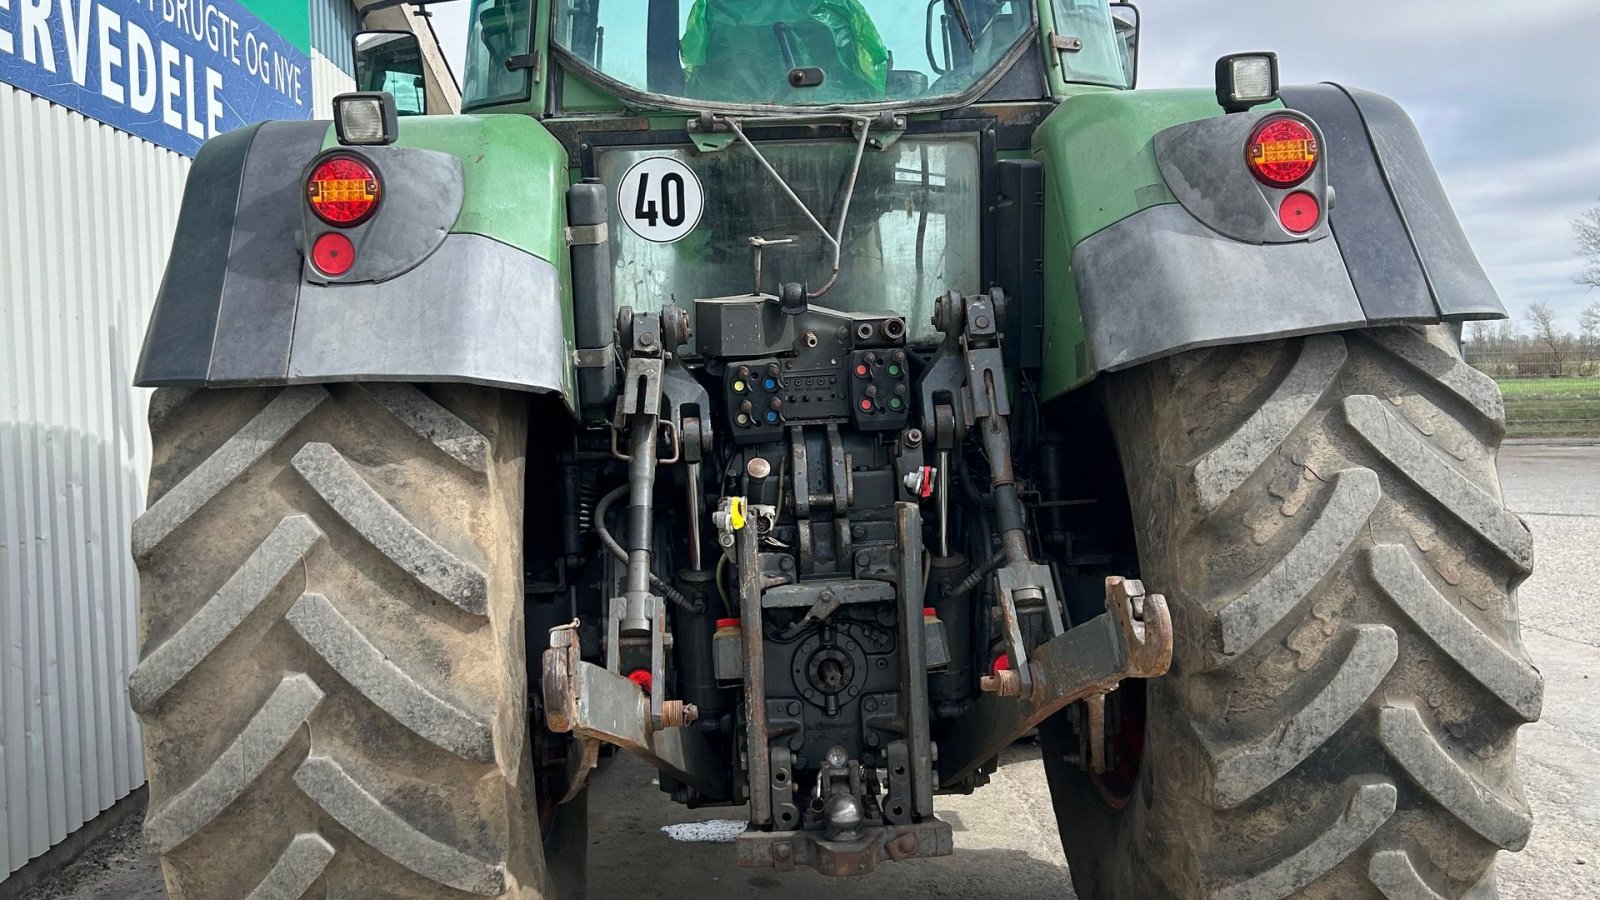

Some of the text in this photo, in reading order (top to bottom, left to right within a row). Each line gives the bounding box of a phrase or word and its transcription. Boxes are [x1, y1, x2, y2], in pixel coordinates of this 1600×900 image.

[0, 0, 223, 140] RVEDELE
[245, 32, 270, 84] OG
[274, 50, 302, 106] NYE
[635, 172, 685, 227] 40
